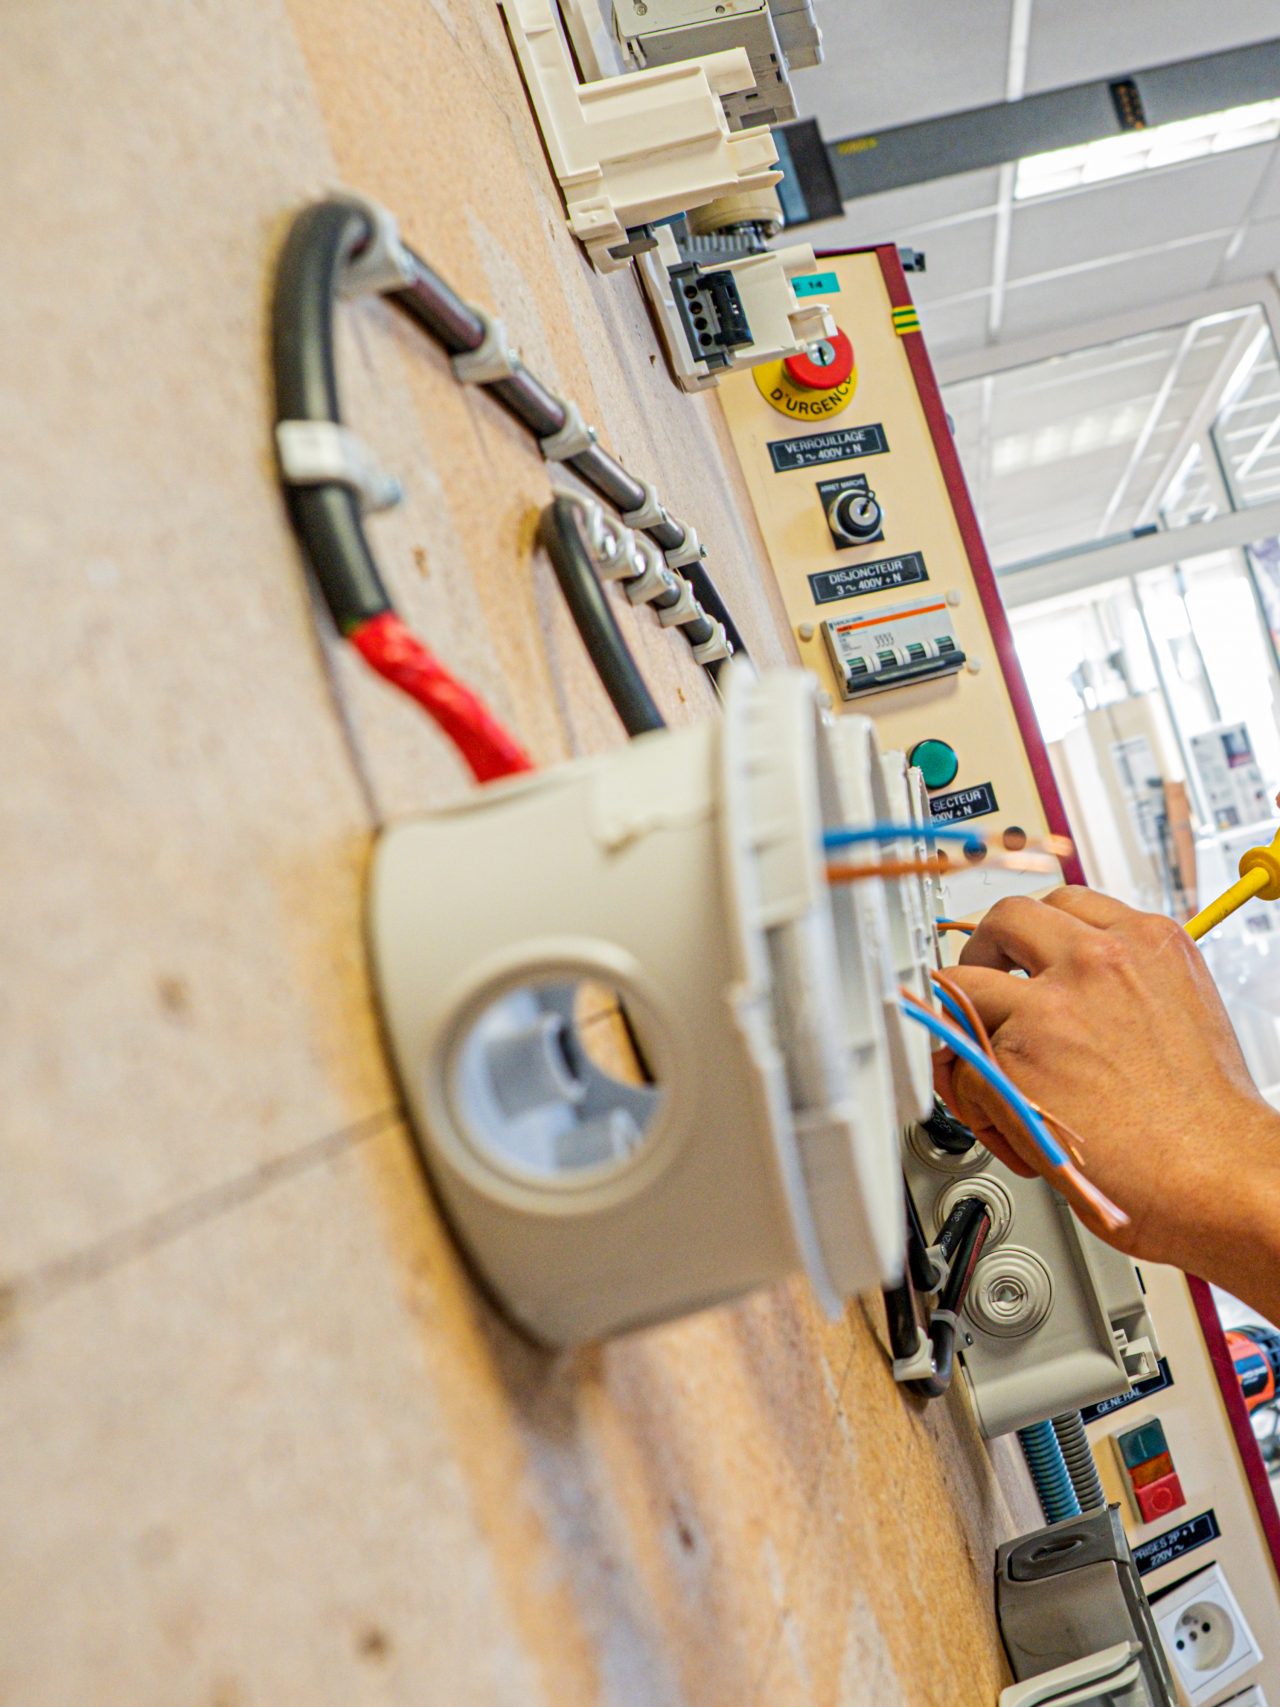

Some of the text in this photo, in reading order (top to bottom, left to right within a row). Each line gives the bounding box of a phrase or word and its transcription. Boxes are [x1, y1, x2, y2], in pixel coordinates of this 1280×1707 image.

[784, 430, 866, 453] VERROUILLAGE
[796, 454, 804, 464] 3
[818, 447, 842, 459] 400V
[853, 443, 862, 453] N
[829, 560, 903, 584] DISJONCTEUR
[836, 585, 844, 595] 3
[858, 577, 882, 589] 400V
[893, 573, 902, 582] N
[932, 790, 982, 812] SECTEUR
[963, 804, 973, 815] N
[1187, 1522, 1197, 1533] T
[1150, 1547, 1173, 1567] 220V
